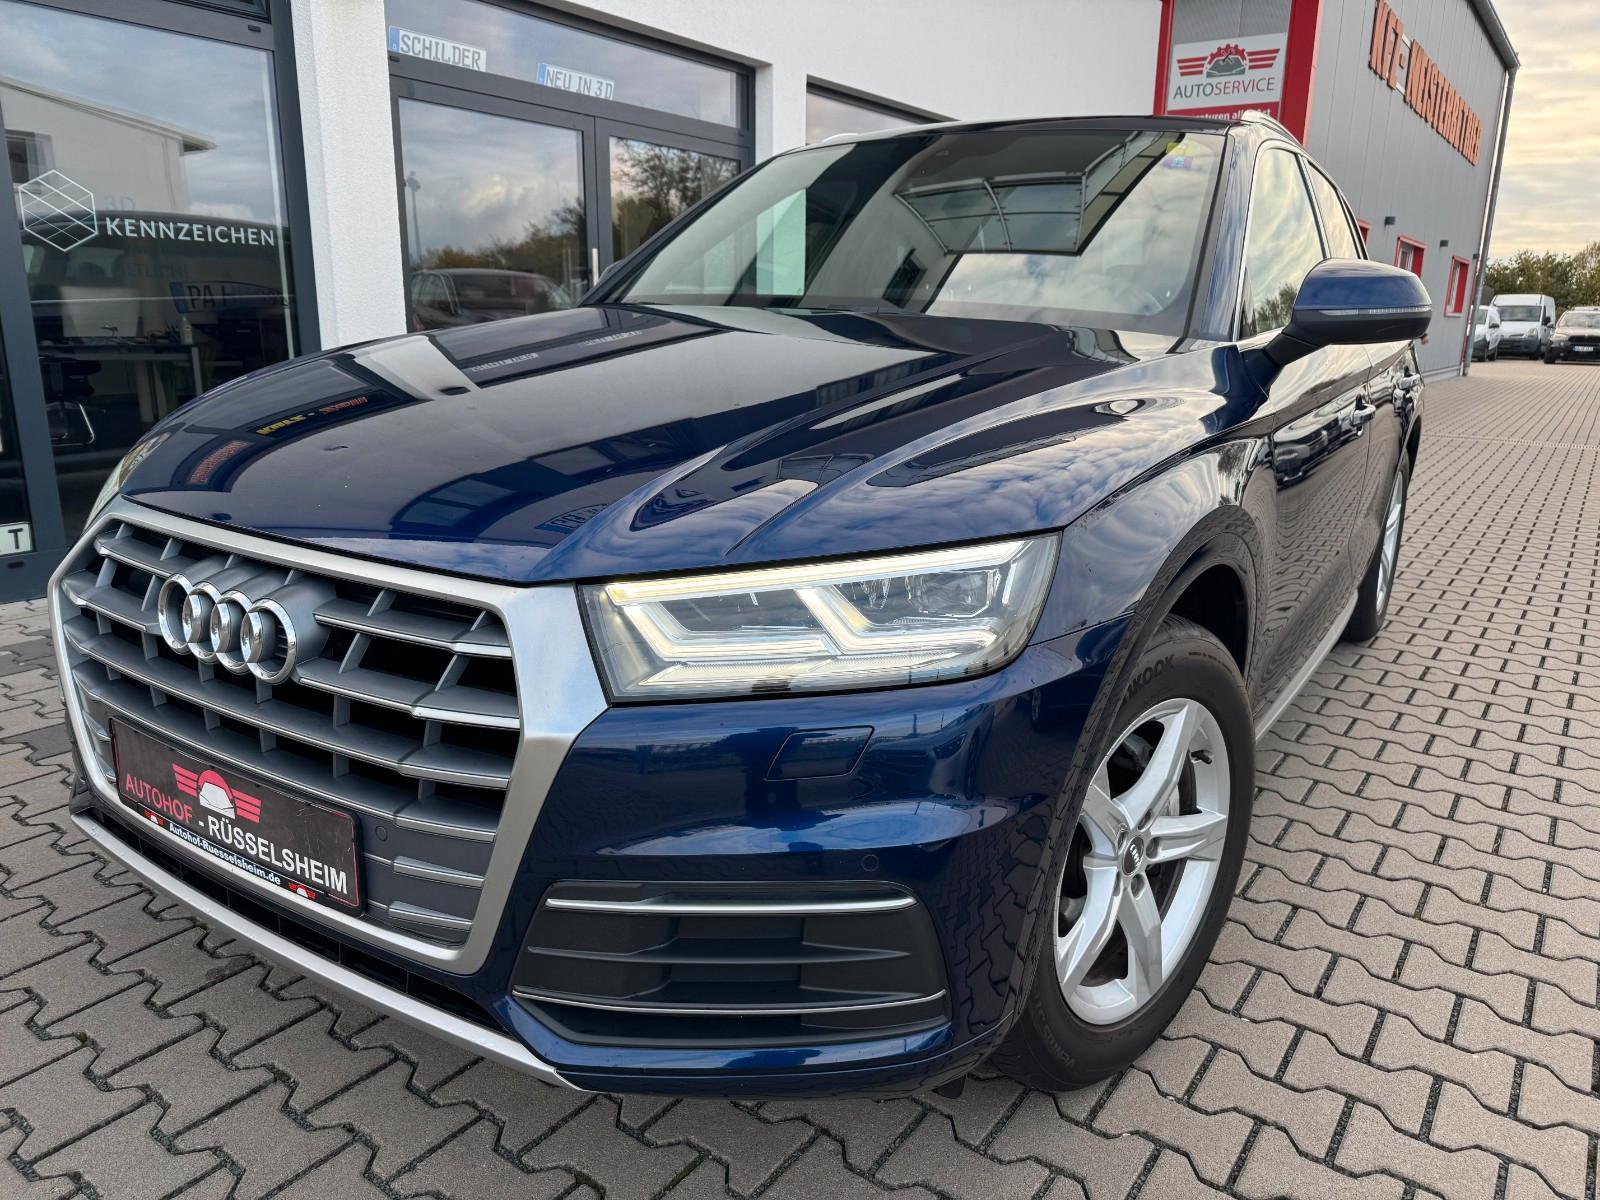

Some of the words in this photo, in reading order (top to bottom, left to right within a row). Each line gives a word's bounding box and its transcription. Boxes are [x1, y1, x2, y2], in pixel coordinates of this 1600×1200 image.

[400, 33, 481, 70] SCHILDER
[546, 69, 572, 91] NEU
[576, 76, 592, 95] IN
[1173, 77, 1276, 100] AUTOSERVICE
[106, 217, 276, 247] KENNZEICHEN
[126, 773, 193, 824] AUTOHOF
[207, 815, 348, 895] RÜSSELSHEIM
[169, 822, 281, 886] Autohof-Ruesselsheim.de
